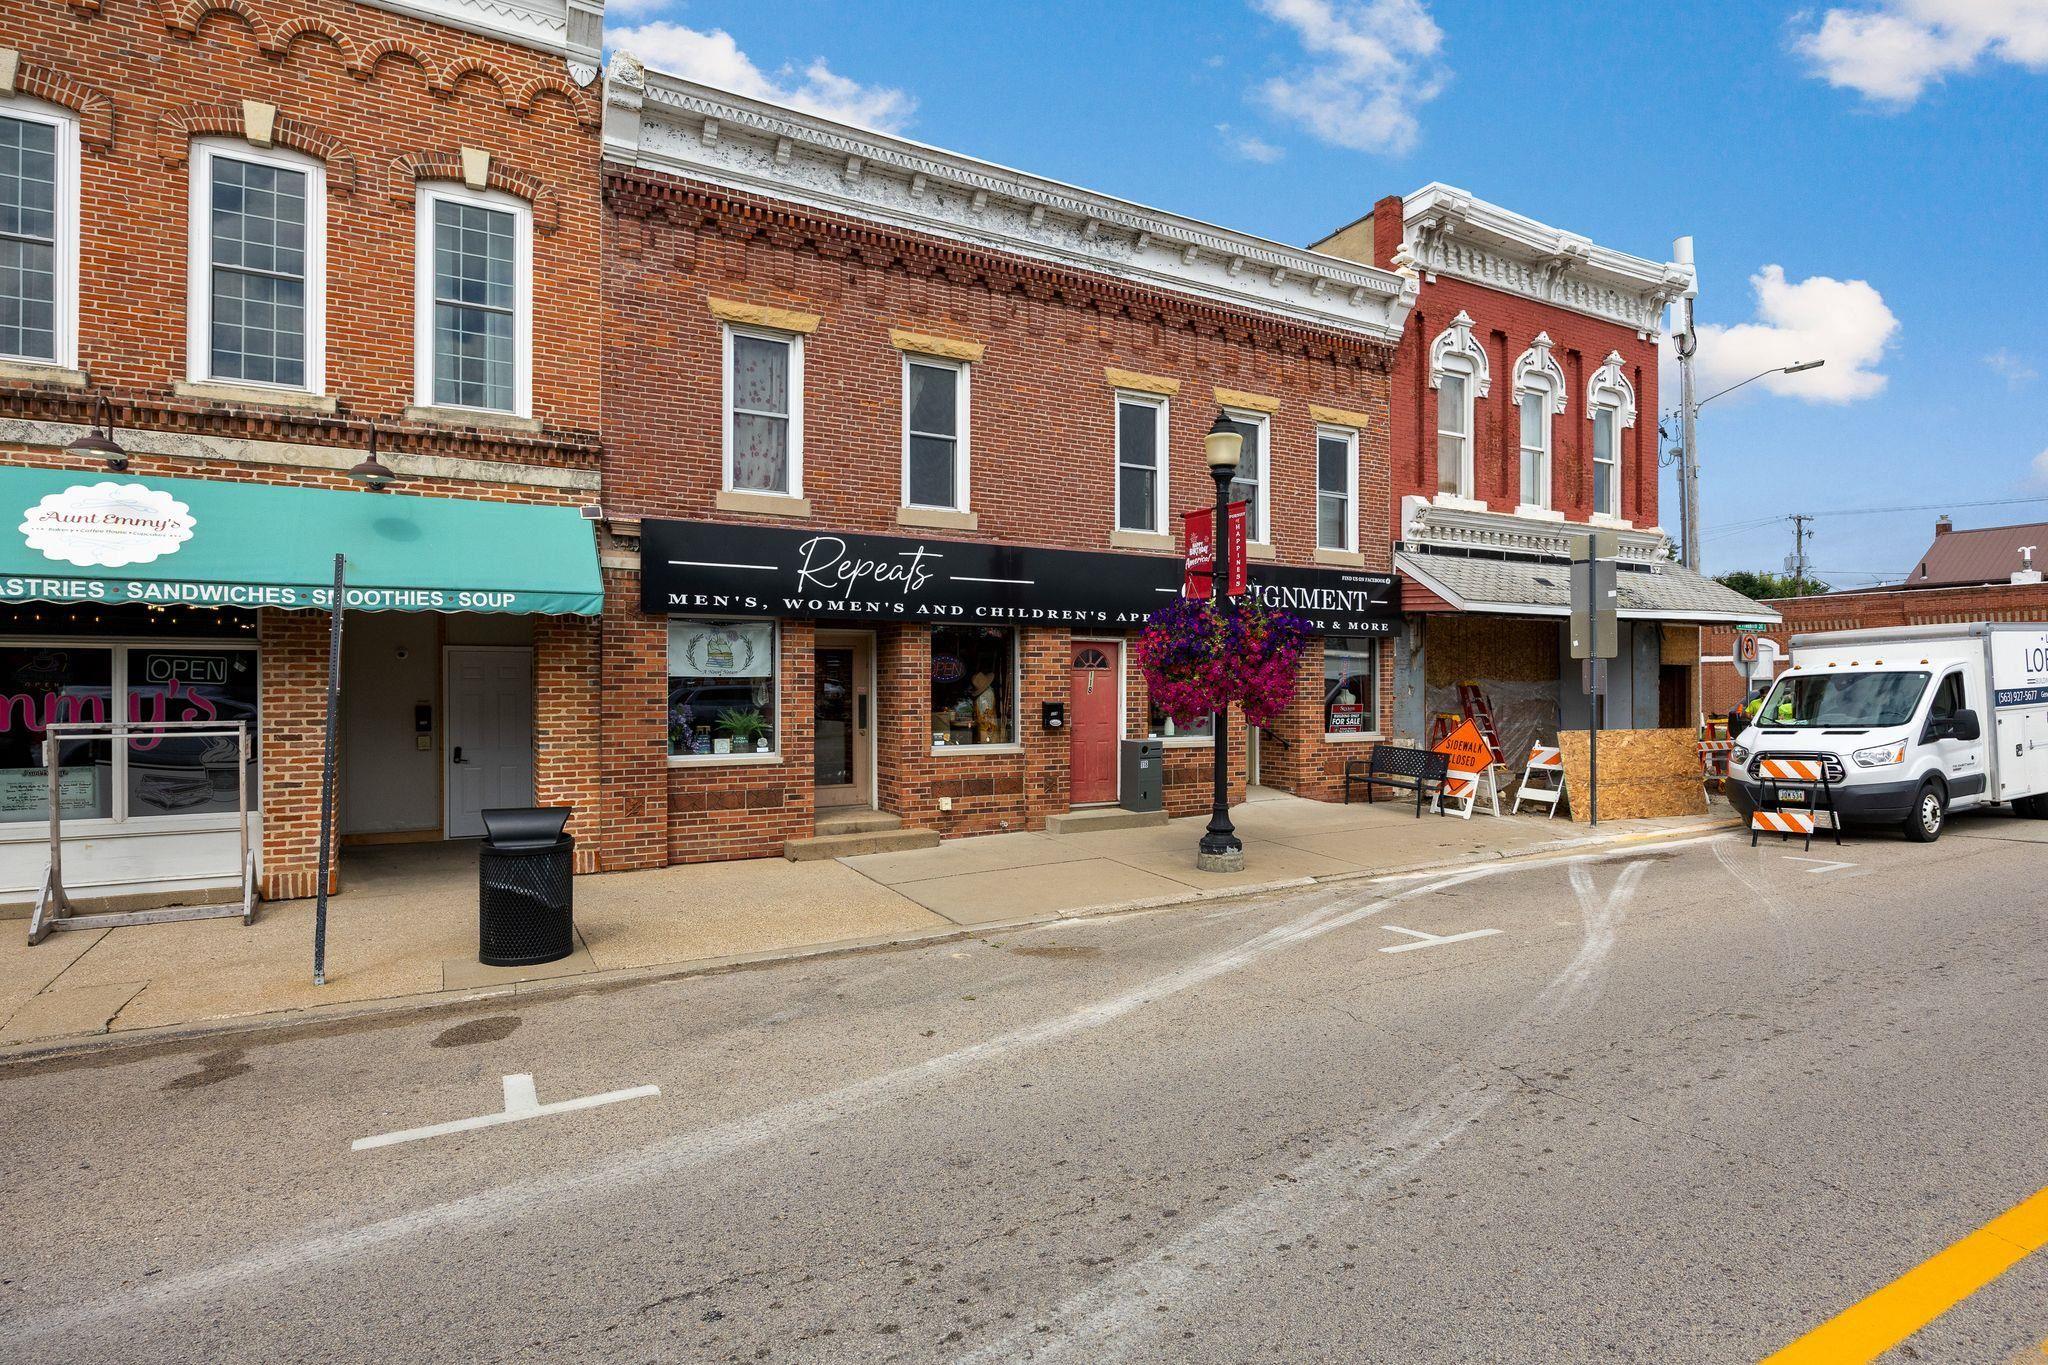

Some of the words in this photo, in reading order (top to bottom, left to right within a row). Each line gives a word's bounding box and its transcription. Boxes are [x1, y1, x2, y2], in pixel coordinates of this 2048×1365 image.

[40, 511, 99, 524] Aunt
[103, 513, 181, 532] Emmy's
[797, 536, 944, 598] Repeats
[1185, 554, 1212, 570] America!
[127, 582, 296, 604] SANDWICHES
[458, 592, 516, 608] SOUP
[668, 593, 768, 610] MEN'S,
[783, 598, 905, 613] WOMEN'S
[916, 604, 964, 616] AND
[975, 606, 1107, 621] CHILDREN'S
[1332, 621, 1341, 629] &
[1348, 622, 1389, 632] MORE
[151, 658, 224, 680] OPEN
[932, 662, 963, 677] PEN
[1998, 691, 2013, 704] (563)
[2013, 690, 2038, 701] 927-5677
[1346, 717, 1361, 725] SALE
[1446, 739, 1484, 754] SIDEWALK
[1448, 754, 1476, 767] LOSED
